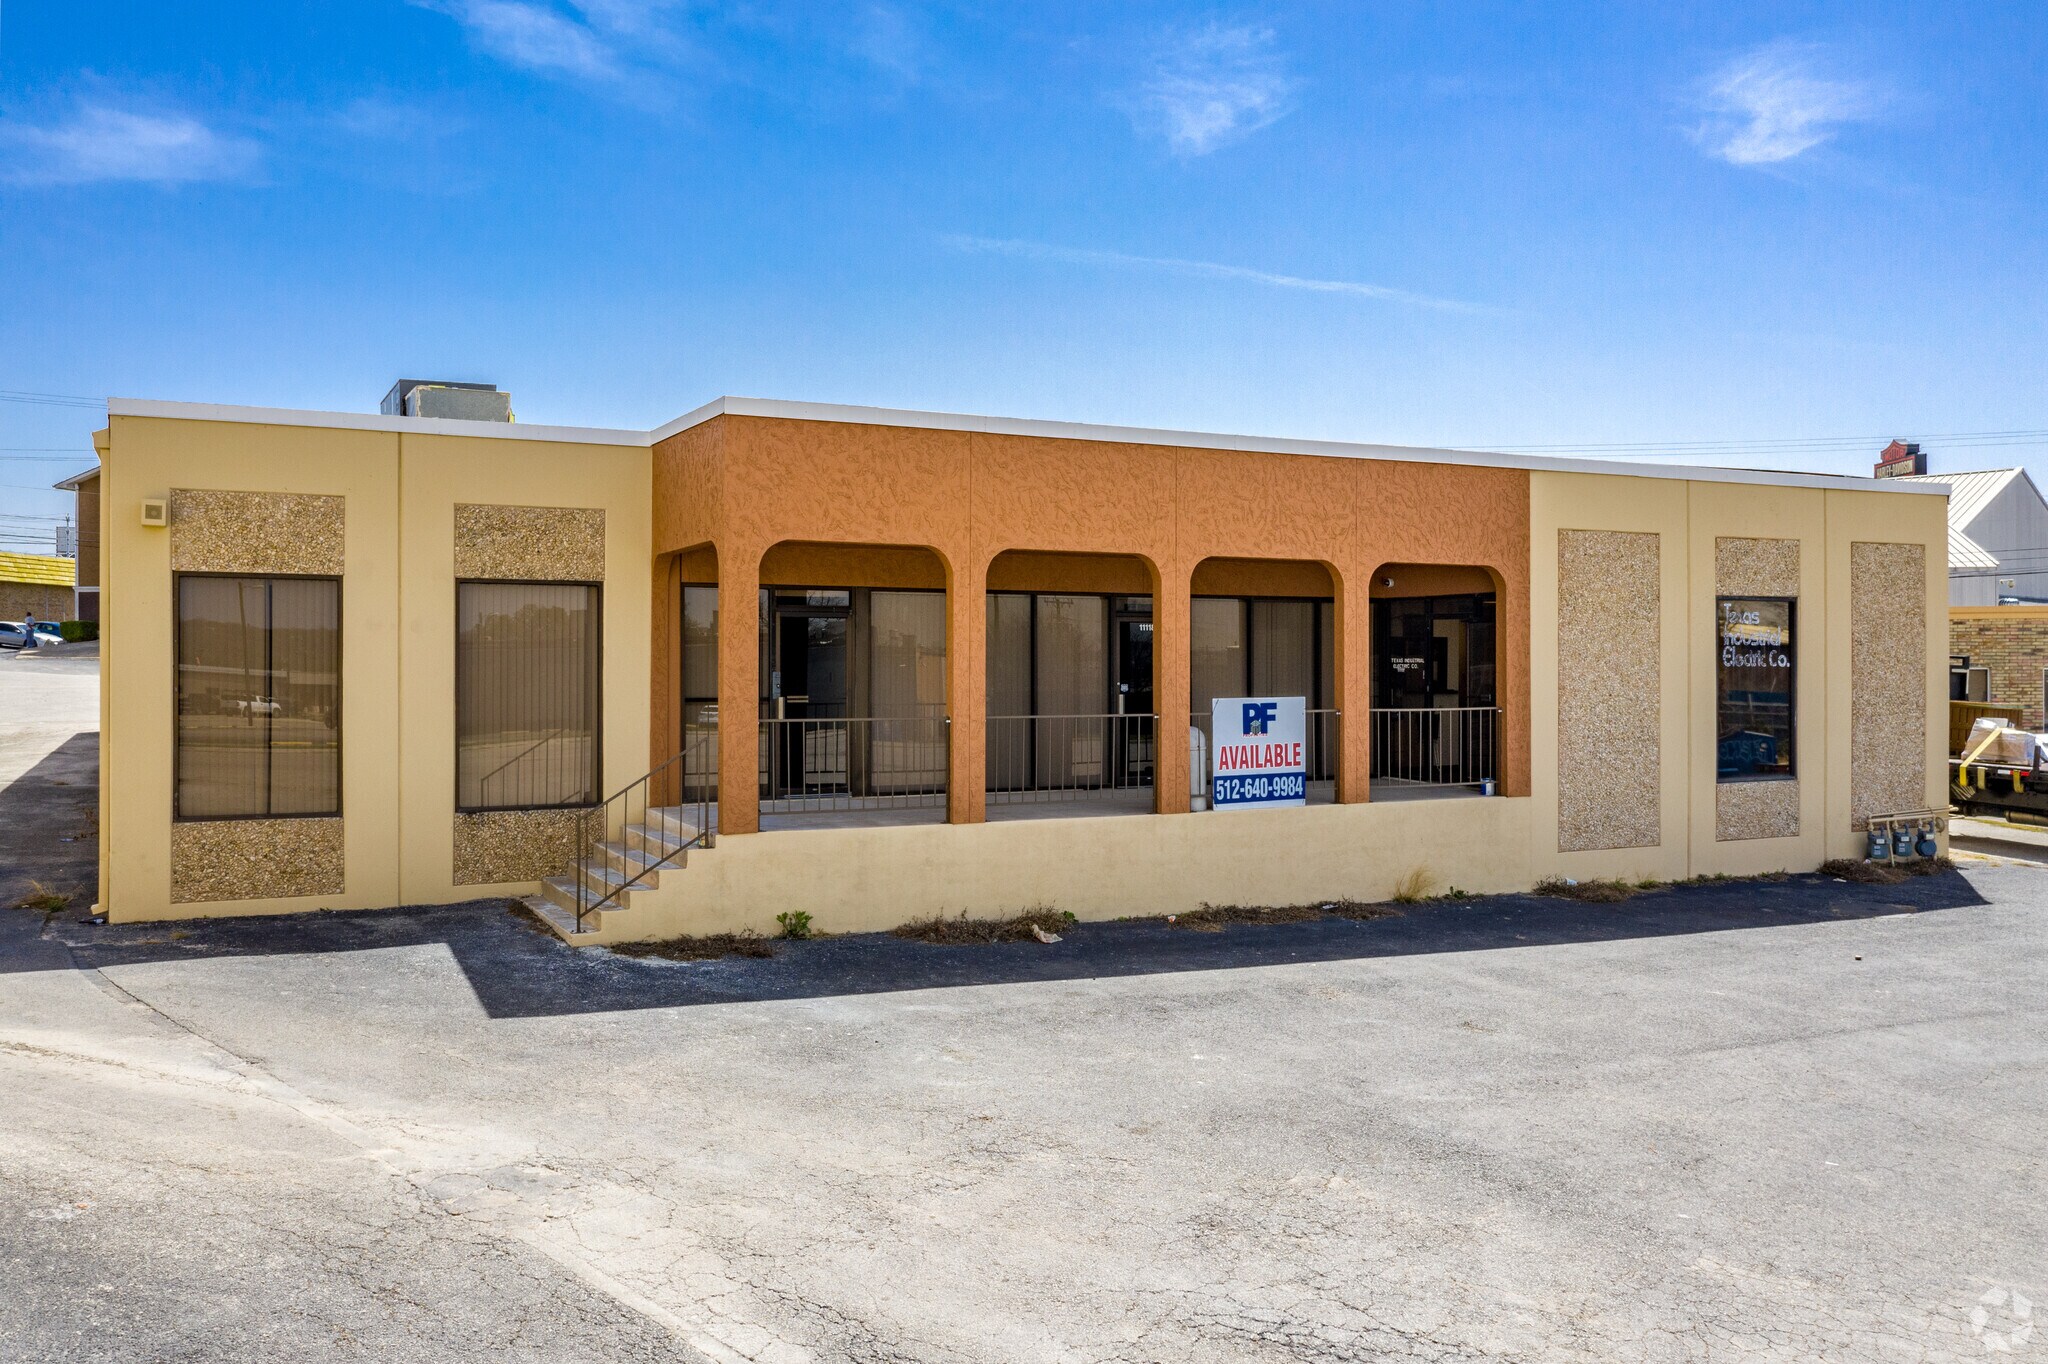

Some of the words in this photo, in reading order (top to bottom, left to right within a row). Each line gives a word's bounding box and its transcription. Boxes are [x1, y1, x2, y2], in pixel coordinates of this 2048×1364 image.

[1768, 649, 1791, 668] Co.
[1242, 702, 1277, 734] PF
[1219, 743, 1302, 770] AVAILABLE
[1216, 776, 1303, 801] 512-640-9984
